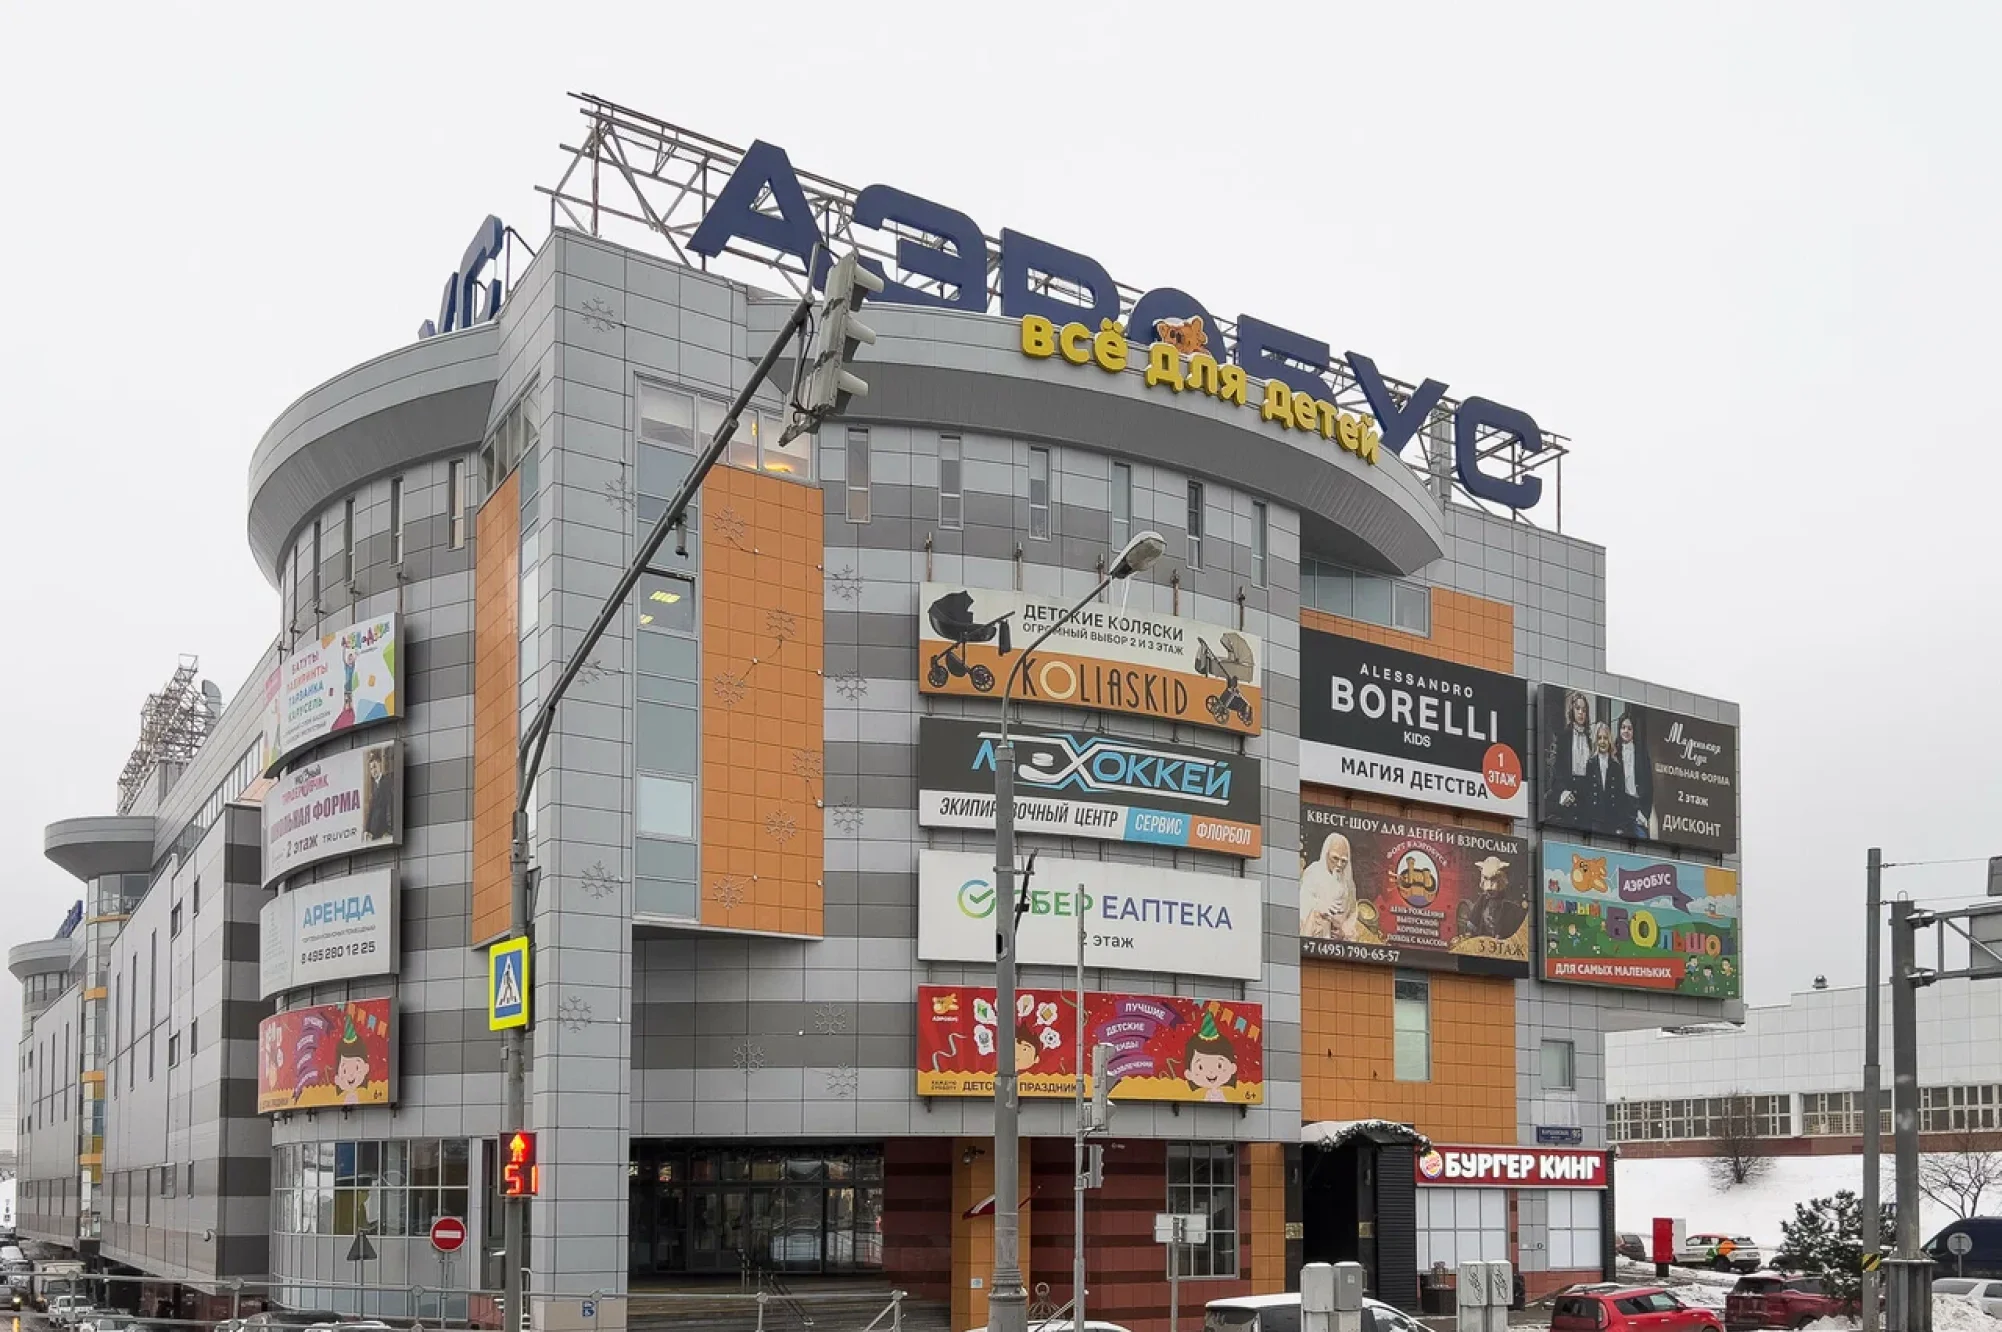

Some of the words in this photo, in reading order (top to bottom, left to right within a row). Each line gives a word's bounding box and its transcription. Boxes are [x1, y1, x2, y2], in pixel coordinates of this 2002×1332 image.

[1144, 345, 1247, 407] для
[1260, 379, 1380, 465] детей
[1024, 604, 1104, 628] ДЕТСКИЕ
[1108, 617, 1185, 642] КОЛЯСКИ
[1090, 631, 1128, 647] ВЫБОР
[1131, 638, 1137, 647] 2
[1138, 639, 1146, 649] И
[1148, 641, 1155, 651] 3
[1156, 643, 1185, 656] ЭТАЖ
[1022, 656, 1189, 716] KOLIASKID
[1360, 663, 1473, 698] ALESSANDRO
[1331, 675, 1498, 742] BORELLI
[1403, 731, 1432, 748] KIDS
[1497, 753, 1504, 767] 1
[1341, 757, 1404, 784] МАГИЯ
[1410, 771, 1489, 800] ДЕТСТВА
[1488, 770, 1517, 788] ЭТАЖ
[1654, 762, 1700, 780] ШКОЛЬНАЯ
[1701, 772, 1731, 787] ФОРМА
[312, 789, 361, 820] ФОРМА
[1677, 790, 1684, 802] 2
[1685, 794, 1709, 807] этаж
[1074, 805, 1119, 829] ЦЕНТР
[1134, 814, 1183, 836] СЕРВИС
[1662, 814, 1722, 837] ДИСКОНТ
[1196, 823, 1252, 846] ФЛОРБОЛ
[1306, 810, 1379, 833] КВЕСТ-ШОУ
[1381, 823, 1405, 836] ДЛЯ
[1407, 826, 1443, 842] ДЕТЕЙ
[1446, 832, 1454, 845] И
[1457, 835, 1518, 855] ВЗРОСЛЫХ
[1623, 873, 1672, 892] АЭРОБУС
[303, 894, 375, 928] АРЕНДА
[1102, 895, 1233, 931] ЕАПТЕКА
[325, 945, 344, 960] 280
[346, 943, 359, 956] 12
[361, 940, 376, 954] 25
[1093, 934, 1135, 949] этаж
[1303, 942, 1316, 953] +7
[1318, 943, 1345, 957] (495)
[1347, 945, 1400, 962] 790-65-57
[1488, 941, 1524, 957] ЭТАЖ
[1555, 963, 1577, 975] ДЛЯ
[1577, 964, 1614, 976] САМЫХ
[1614, 965, 1672, 979] МАЛЕНЬКИХ
[1125, 1002, 1166, 1021] ЛУЧШИЕ
[1105, 1022, 1146, 1037] ДЕТСКИЕ
[1245, 1091, 1257, 1100] 6+
[1445, 1152, 1535, 1178] БУРГЕР
[1539, 1155, 1600, 1180] КИНГ
[504, 1164, 539, 1194] 51
